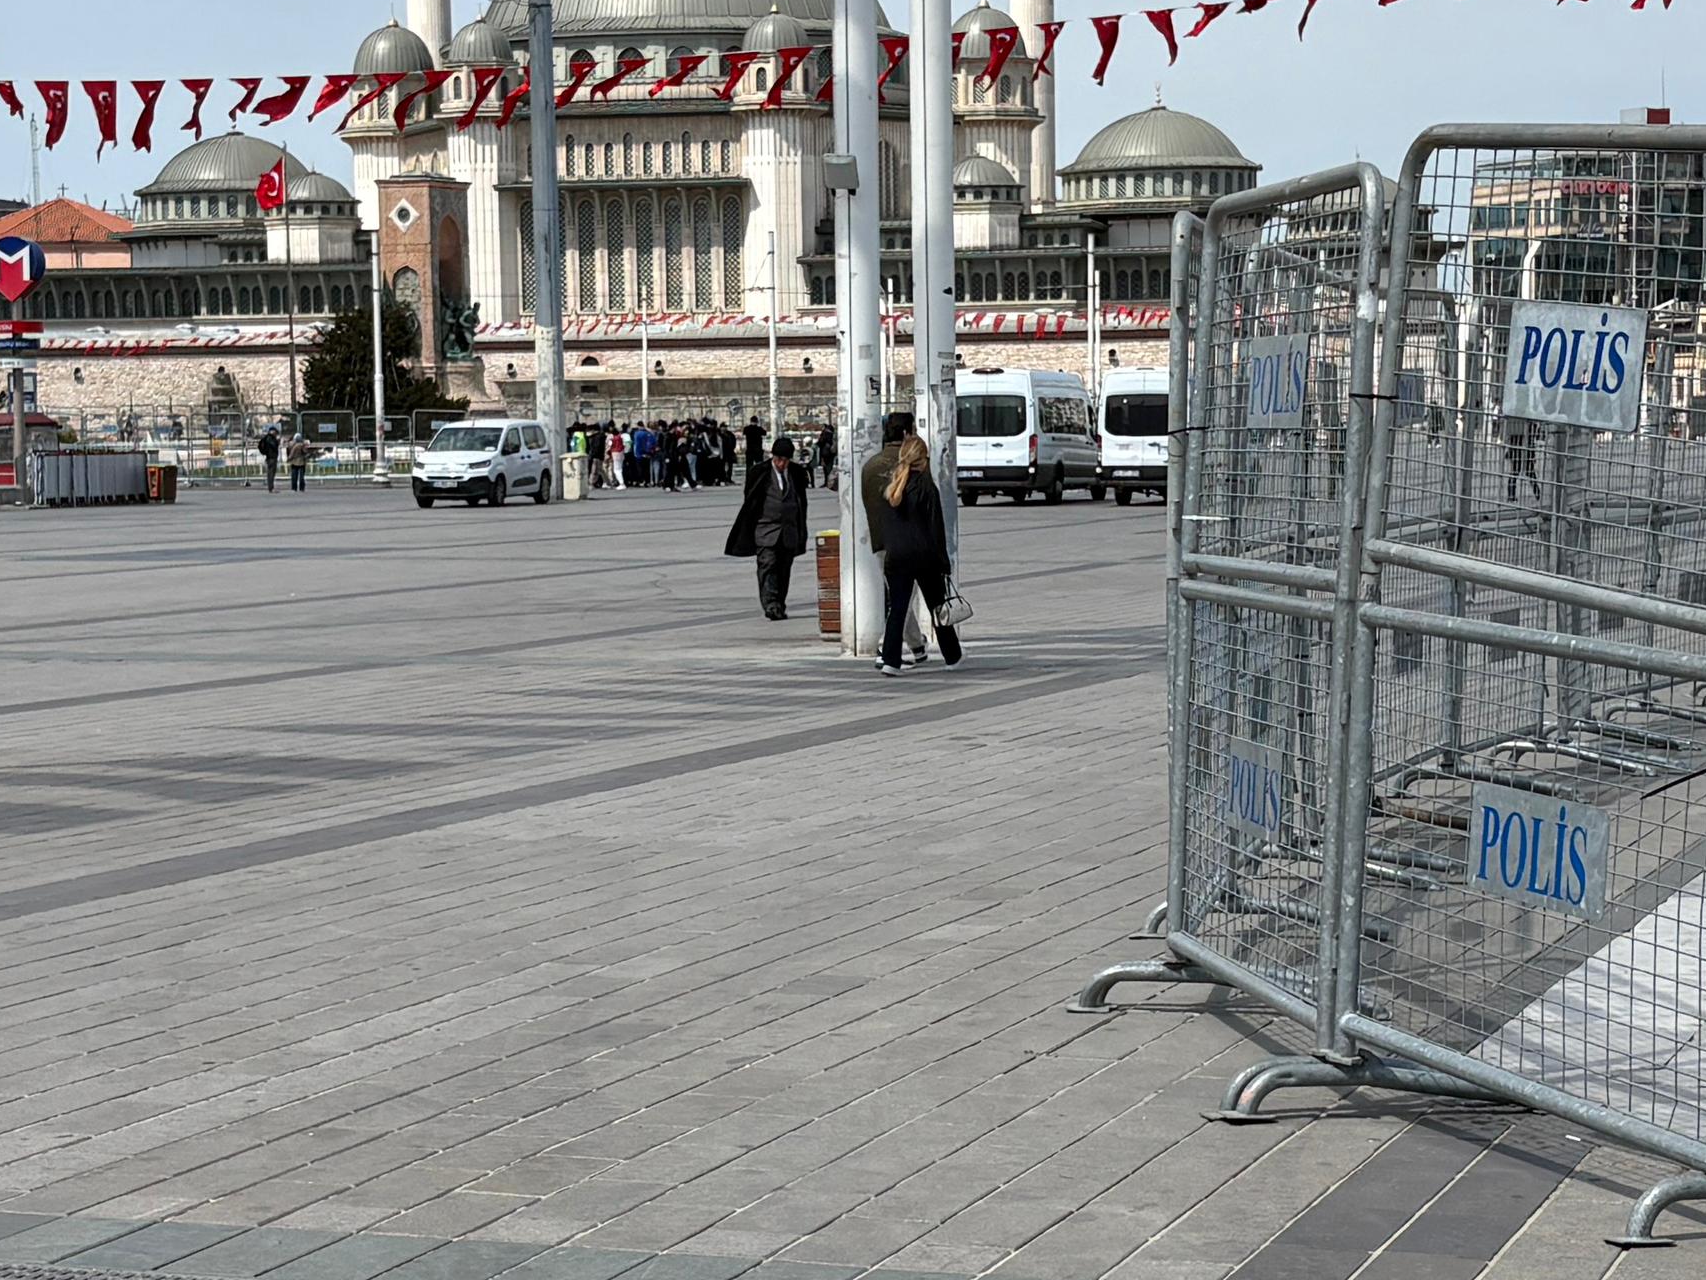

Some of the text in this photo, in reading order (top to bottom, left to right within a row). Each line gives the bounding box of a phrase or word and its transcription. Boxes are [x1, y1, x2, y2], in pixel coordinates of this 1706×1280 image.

[1619, 194, 1628, 242] HOTEL
[1250, 347, 1304, 416] POLİS
[1515, 312, 1630, 394] POLİS
[1230, 755, 1280, 833] POLİS
[1478, 806, 1589, 906] POLİS
